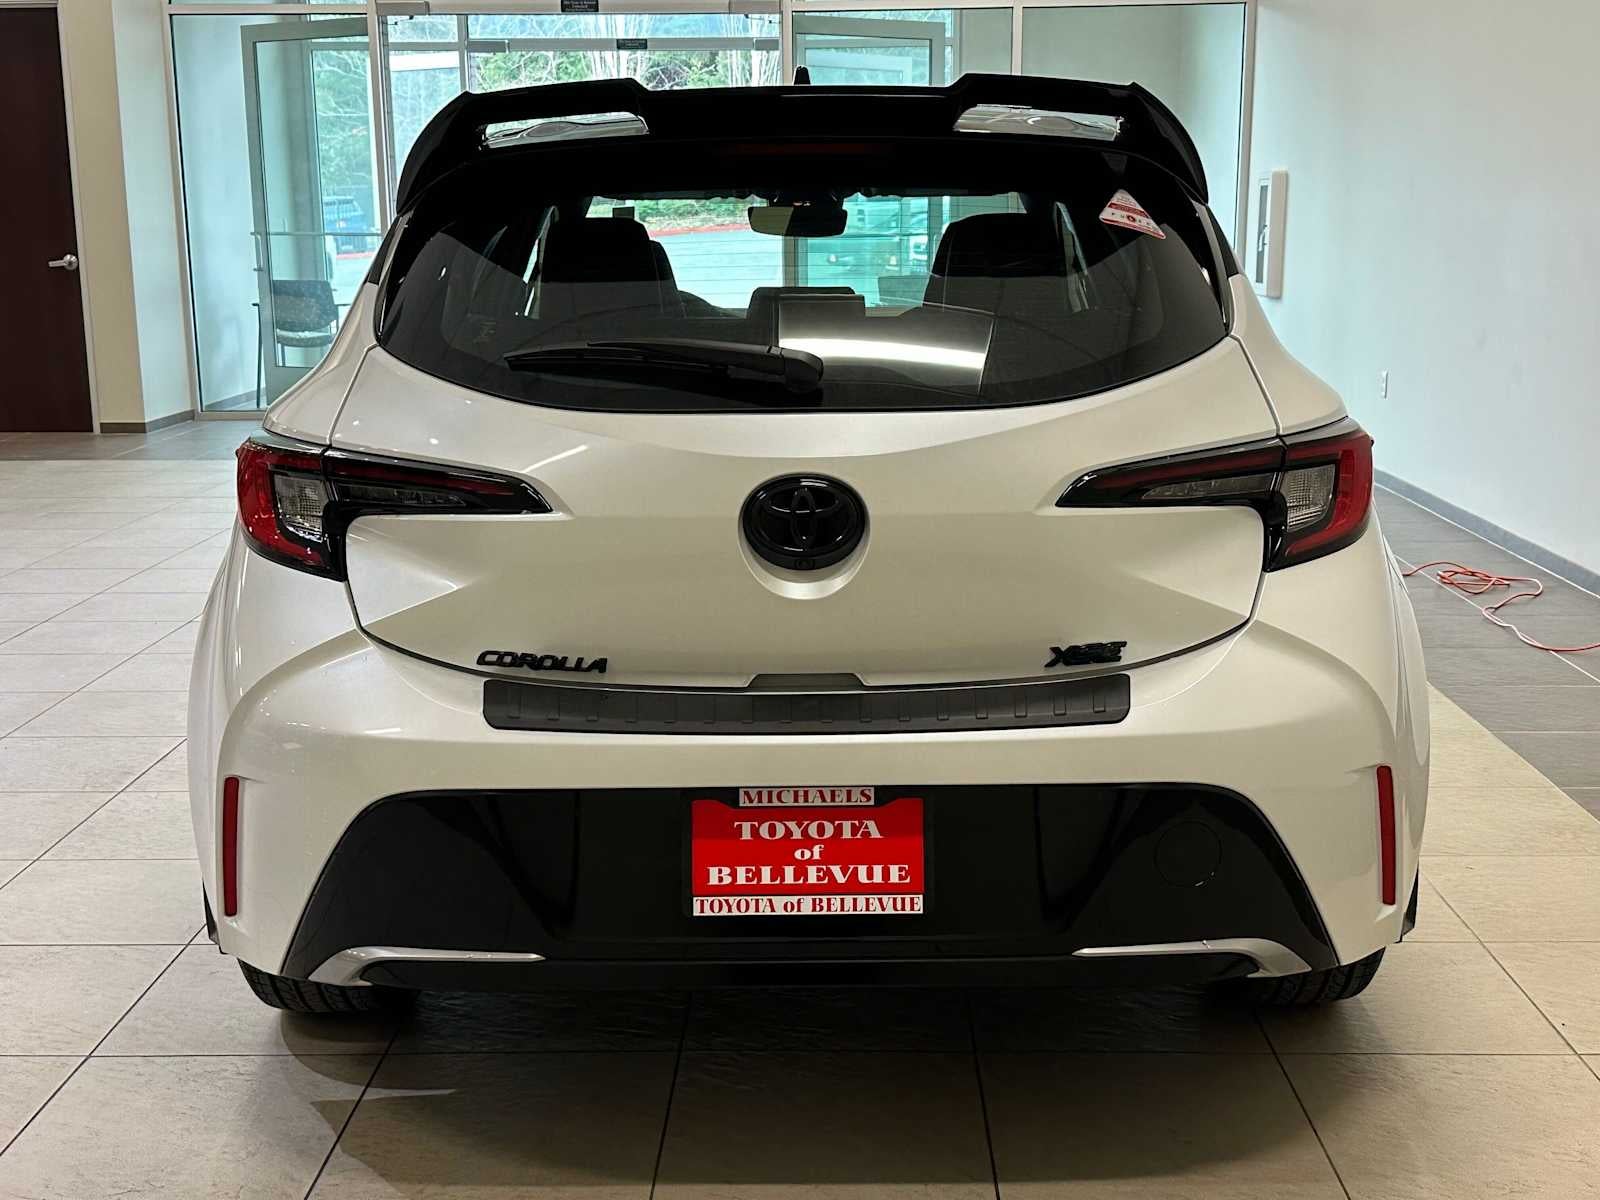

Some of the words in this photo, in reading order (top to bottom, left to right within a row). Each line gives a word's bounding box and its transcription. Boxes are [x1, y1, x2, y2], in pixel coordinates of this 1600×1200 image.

[476, 651, 608, 673] COROLLA
[743, 789, 872, 804] MICHAELS
[734, 820, 883, 840] TOYOTA
[794, 844, 825, 860] of
[707, 864, 911, 885] BELLEVUE
[697, 898, 776, 914] TOYOTA
[783, 897, 804, 912] of
[811, 896, 921, 912] BELLEVUE
